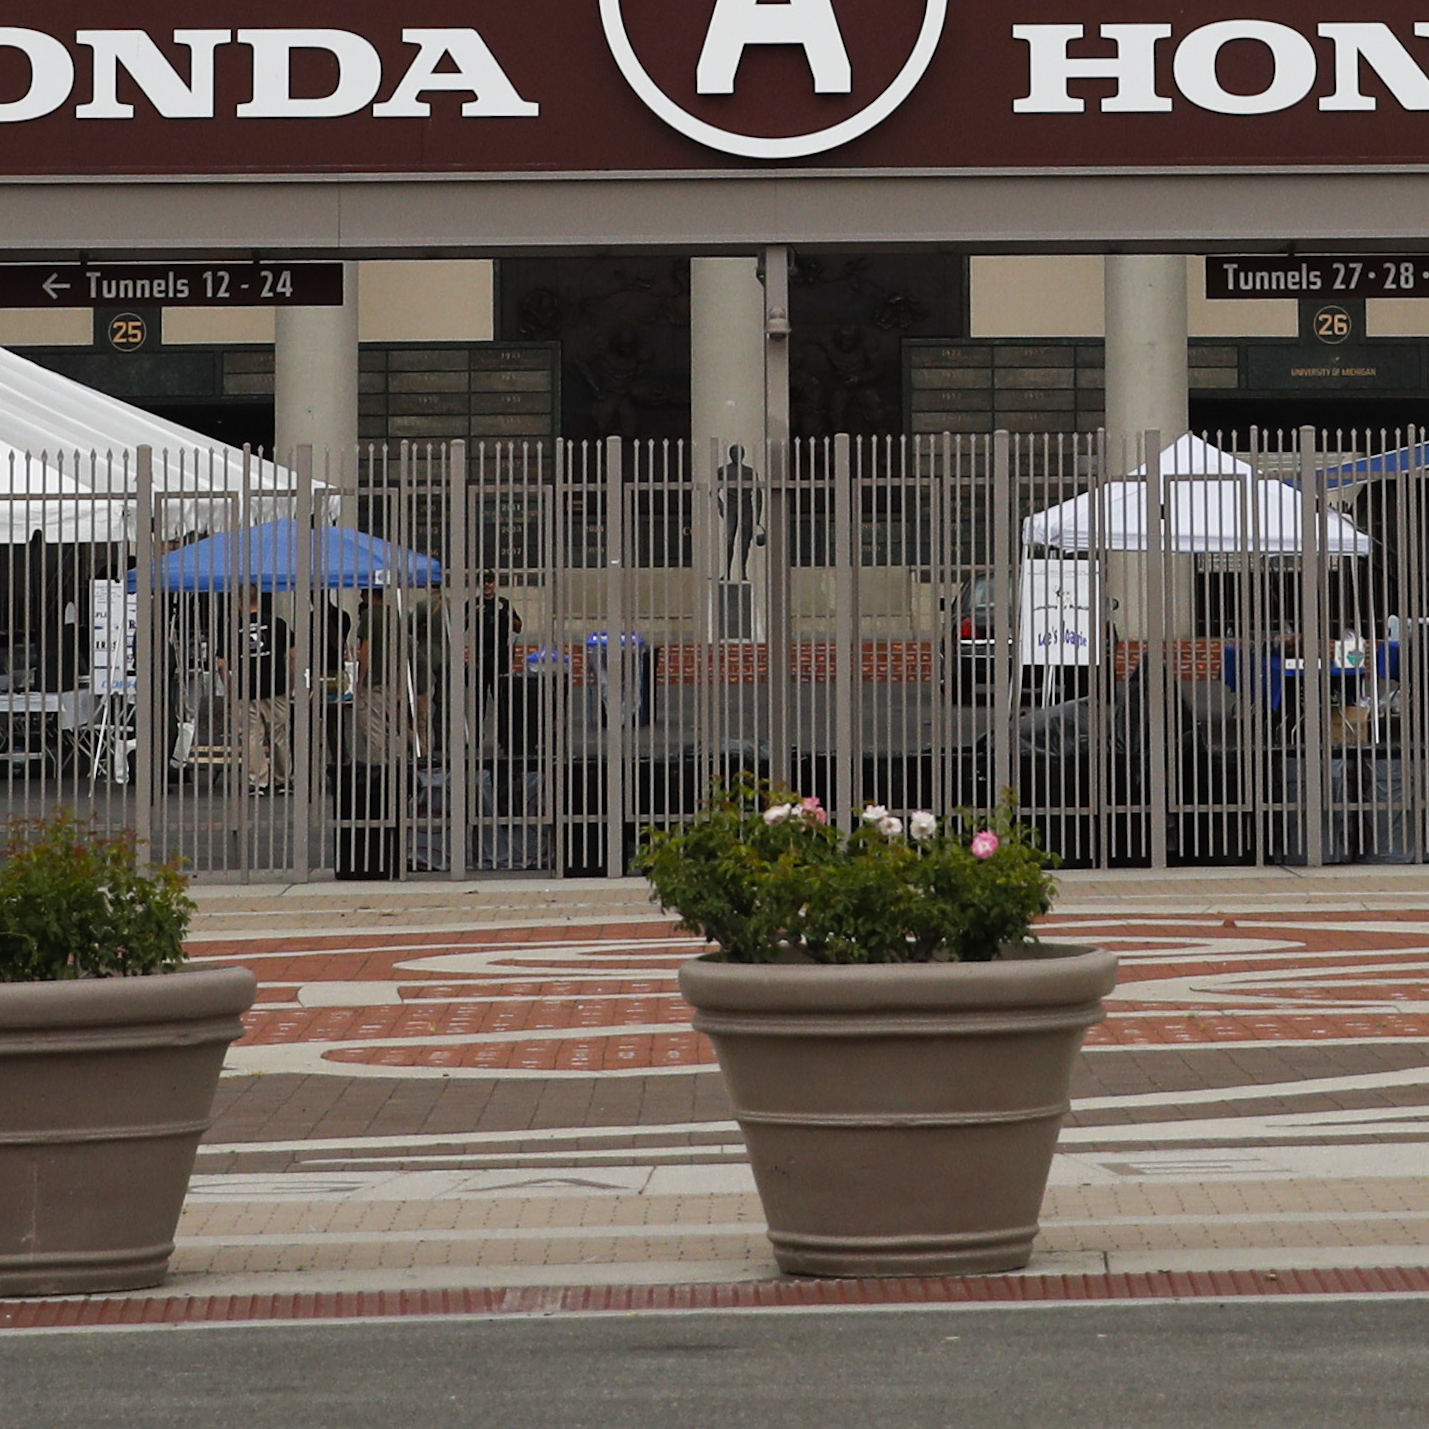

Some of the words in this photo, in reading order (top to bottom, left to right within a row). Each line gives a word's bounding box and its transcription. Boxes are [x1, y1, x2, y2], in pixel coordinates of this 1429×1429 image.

[85, 271, 189, 299] Tunnels
[202, 270, 230, 298] 12
[259, 270, 293, 298] 24
[1223, 262, 1322, 290] Tunnels
[112, 321, 142, 344] 25
[1318, 313, 1348, 336] 26
